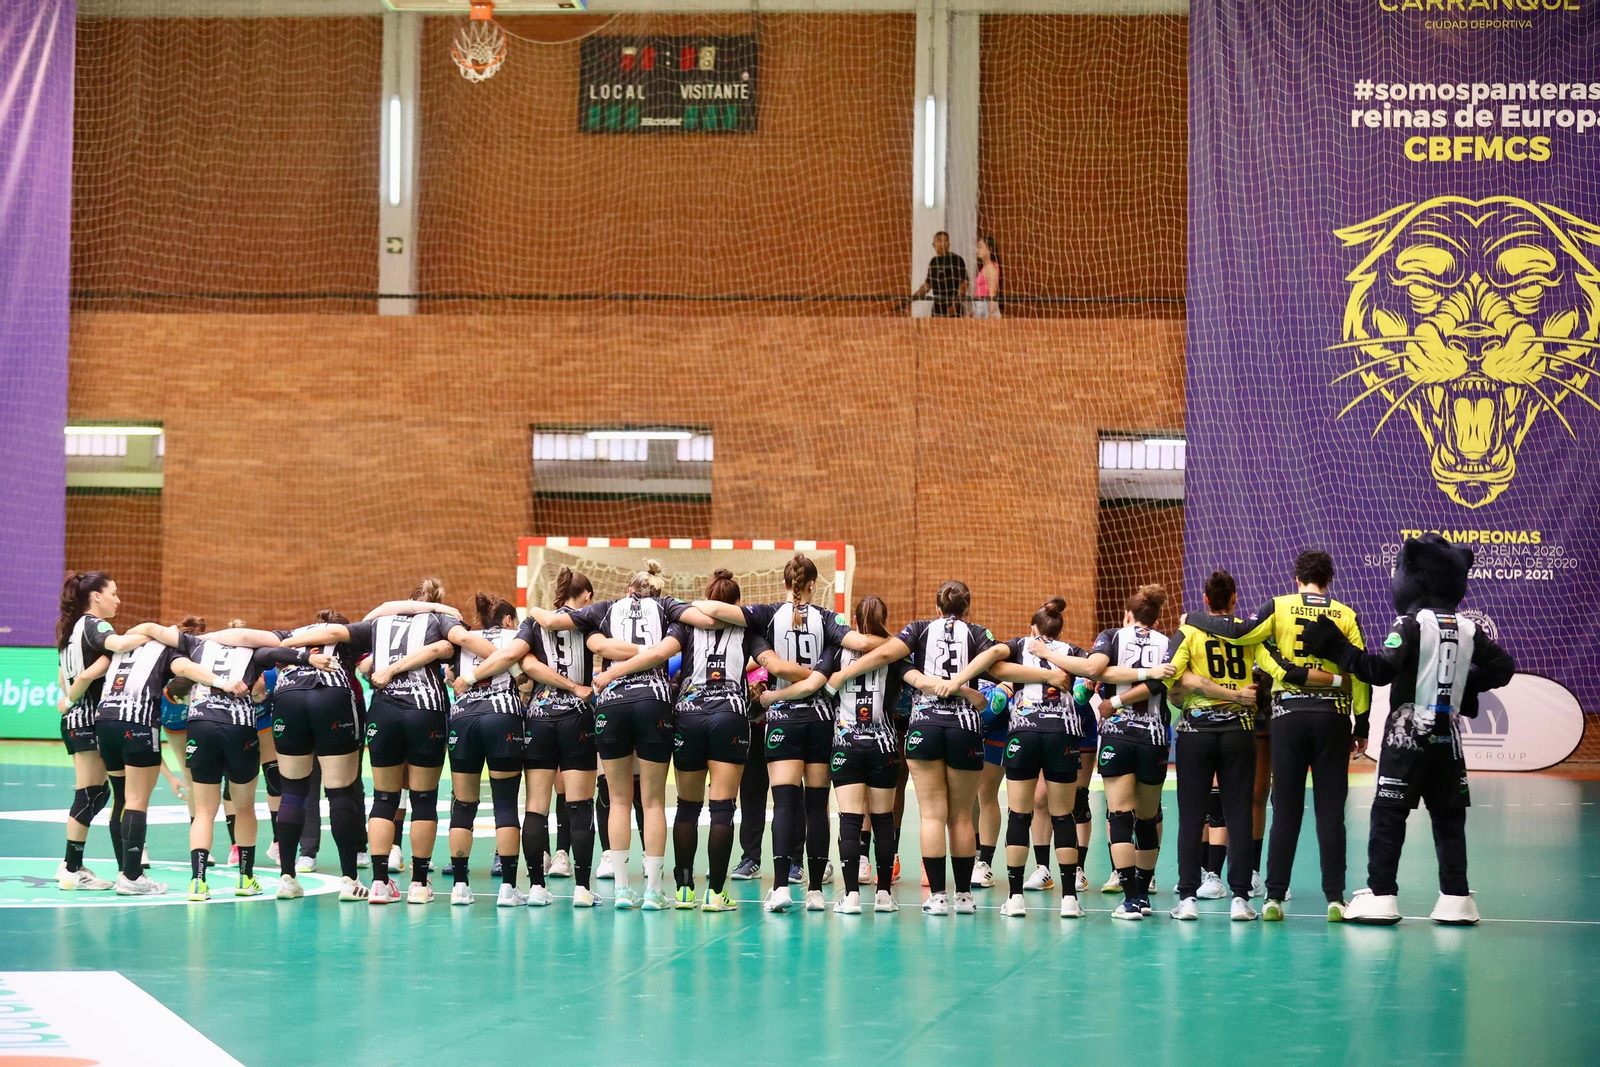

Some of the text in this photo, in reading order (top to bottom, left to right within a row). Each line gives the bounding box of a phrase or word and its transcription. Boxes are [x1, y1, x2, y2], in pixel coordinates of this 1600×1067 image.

[1379, 0, 1581, 11] CARRANQUE
[1425, 19, 1533, 29] CIUDAD DEPORTIVA
[590, 83, 749, 99] LOCAL VISITANTE
[1353, 79, 1600, 105] #somospanteras
[1351, 102, 1600, 133] reinas de Europ
[1404, 136, 1551, 161] CBFMCS
[1401, 529, 1541, 544] TRAMPEONAS
[1491, 545, 1531, 556] REINA
[1533, 546, 1565, 556] 2020
[1525, 557, 1544, 568] DE
[1546, 558, 1578, 569] 2020
[1495, 569, 1522, 580] CUP
[1525, 569, 1554, 580] 2021
[621, 618, 655, 648] 15
[785, 630, 818, 670] 19
[935, 639, 964, 679] 23
[1205, 640, 1246, 680] 68
[1437, 641, 1458, 684] 8
[856, 696, 873, 705] raíz
[1475, 752, 1527, 760] GROUP
